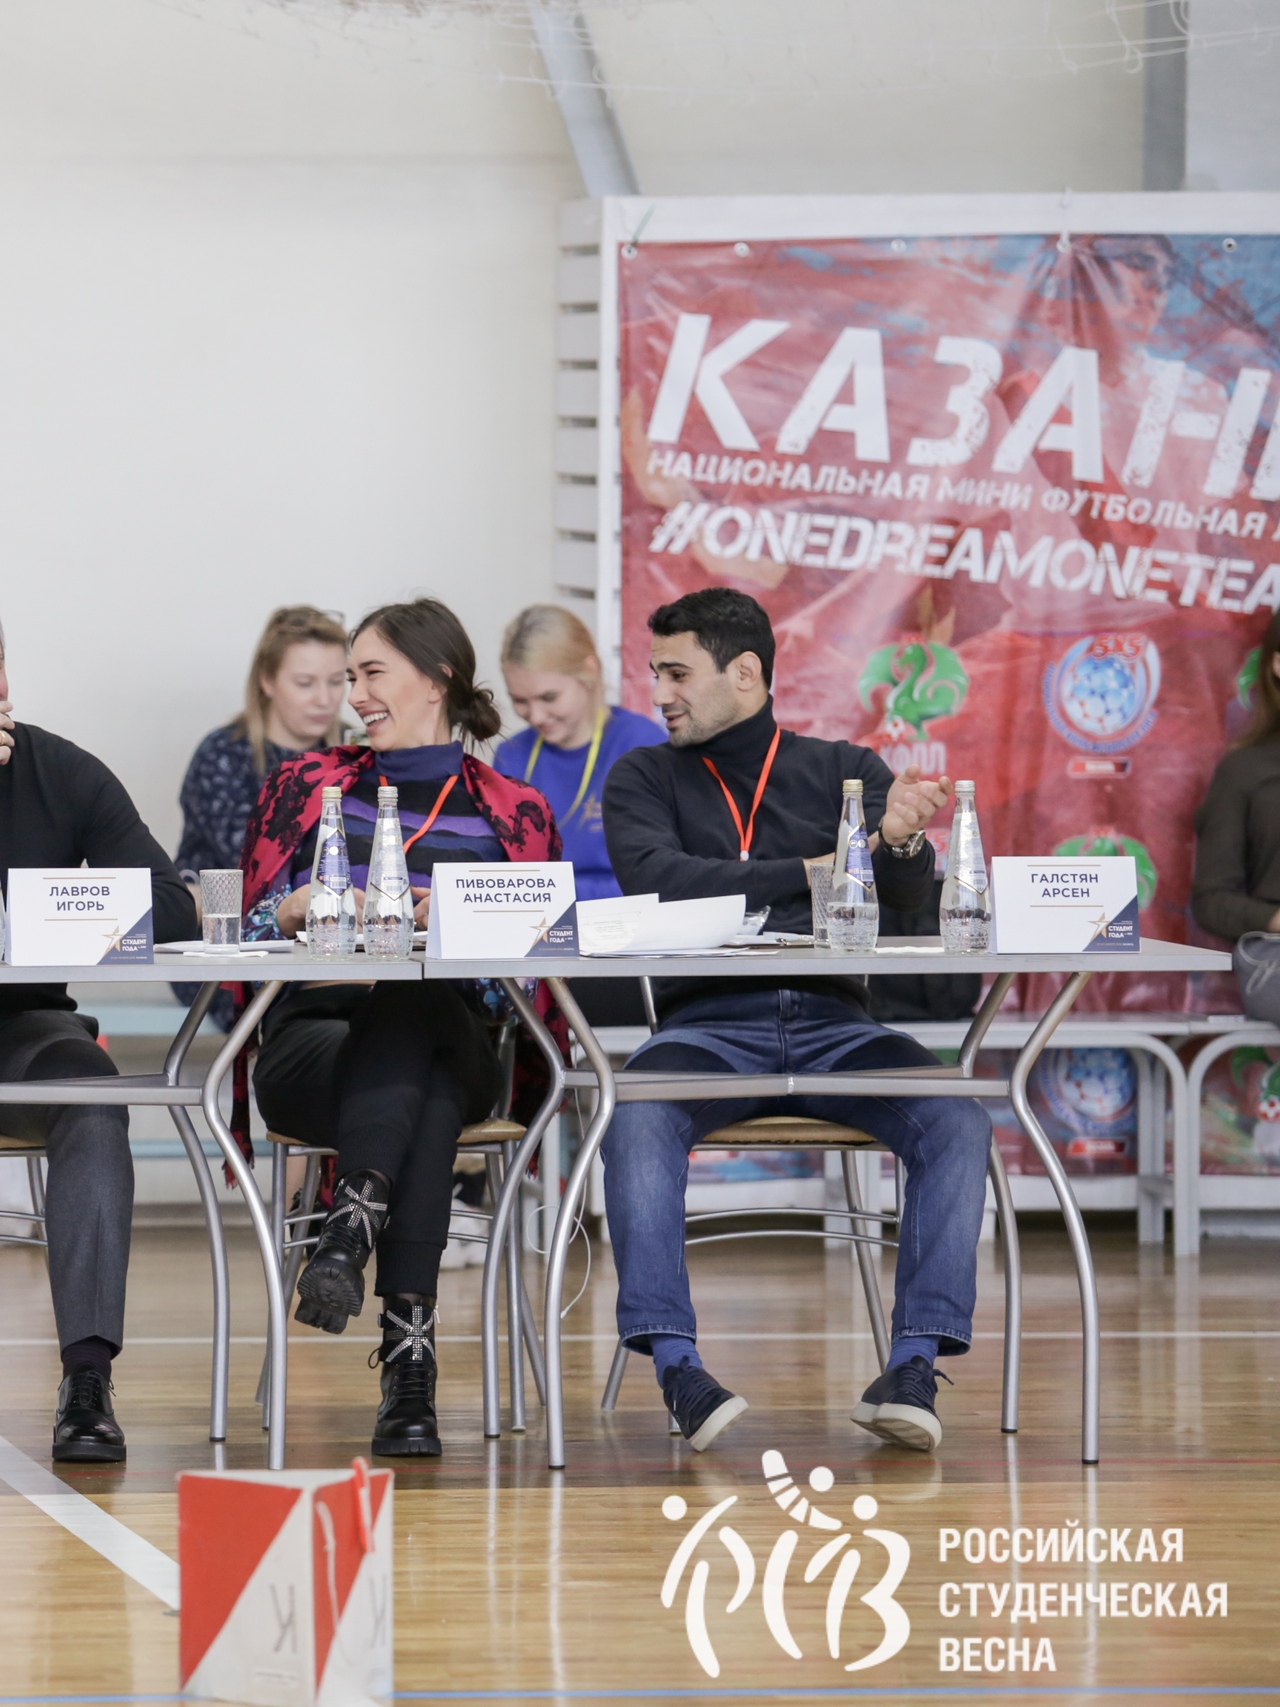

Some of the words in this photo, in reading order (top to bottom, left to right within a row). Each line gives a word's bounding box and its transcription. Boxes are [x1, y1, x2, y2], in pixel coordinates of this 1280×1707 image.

[646, 449, 931, 501] НАЦИОНАЛЬНАЯ
[935, 475, 1033, 511] МИНИ
[1040, 485, 1269, 540] ФУТБОЛЬНАЯ
[455, 878, 556, 889] ПИВОВАРОВА
[1031, 873, 1099, 884] ГАЛСТЯН
[49, 886, 111, 897] ЛАВРОВ
[1041, 887, 1090, 898] АРСЕН
[463, 892, 552, 903] АНАСТАСИЯ
[56, 900, 105, 911] ИГОРЬ
